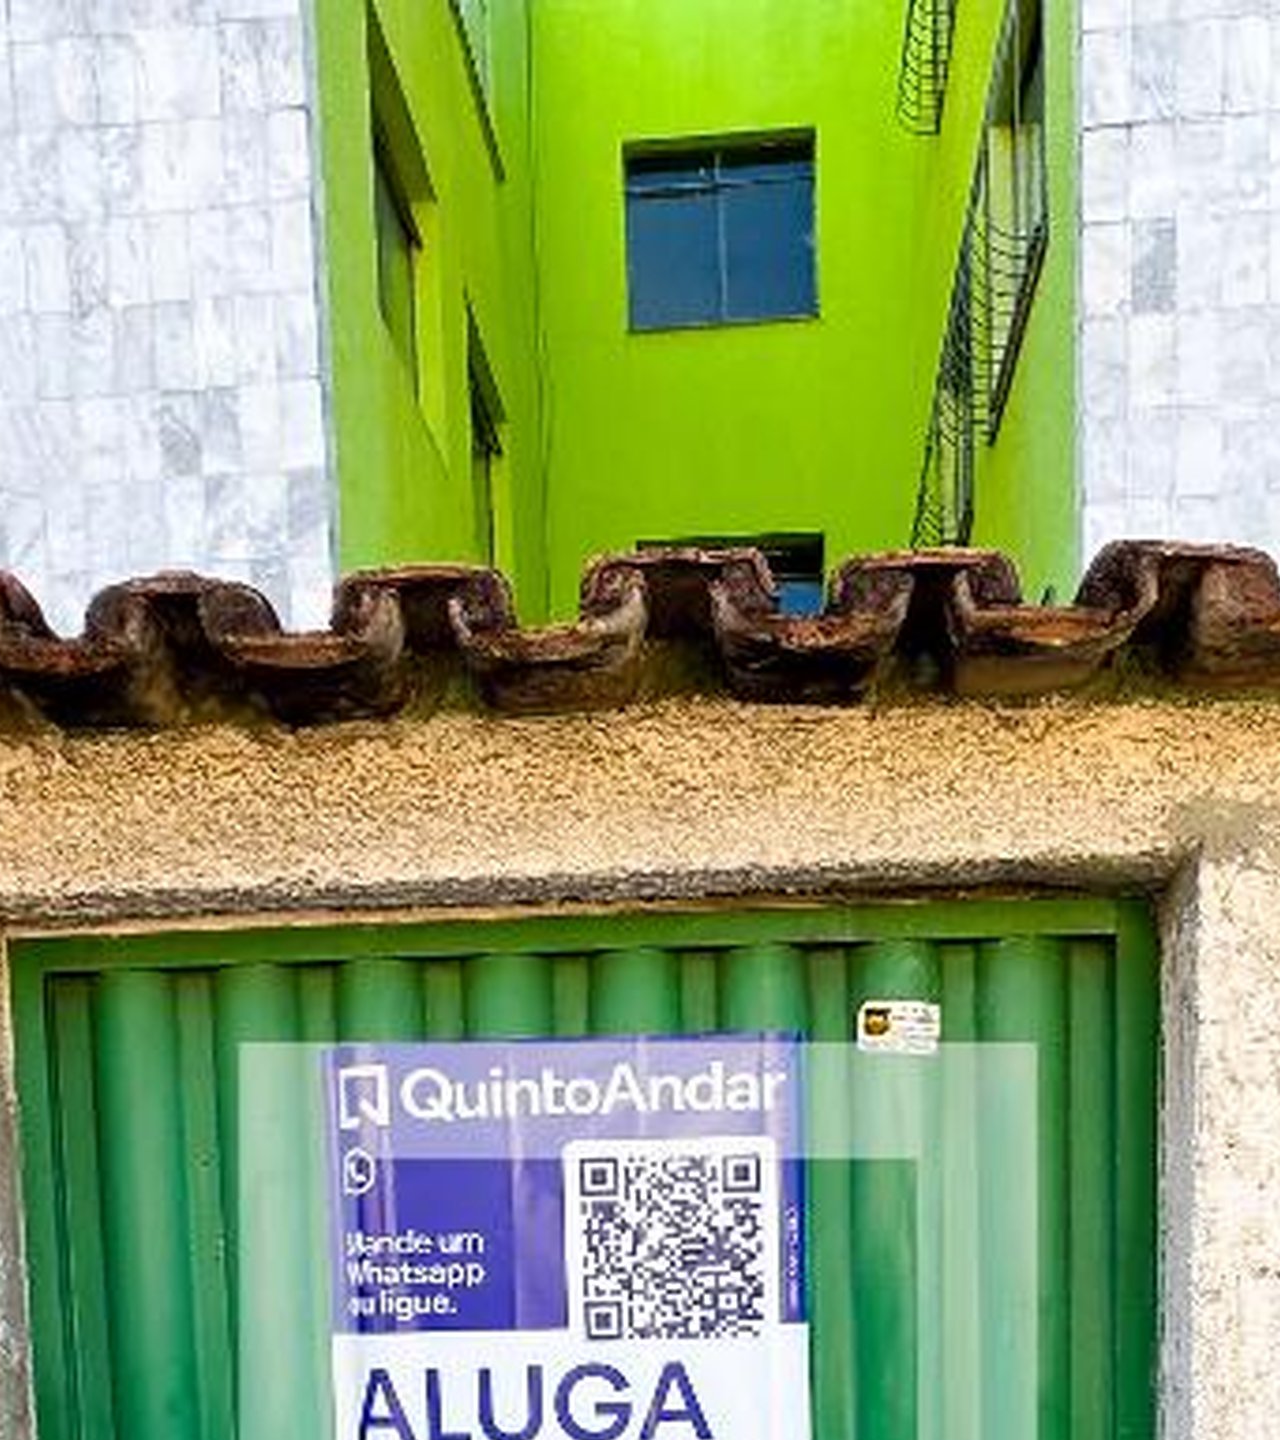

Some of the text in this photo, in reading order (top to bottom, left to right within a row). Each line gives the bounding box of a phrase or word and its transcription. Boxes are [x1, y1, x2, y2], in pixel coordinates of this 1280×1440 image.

[401, 1062, 786, 1121] QuintoAndar
[438, 1232, 485, 1254] um
[347, 1259, 486, 1289] Whatsapp
[380, 1288, 458, 1322] ligue.
